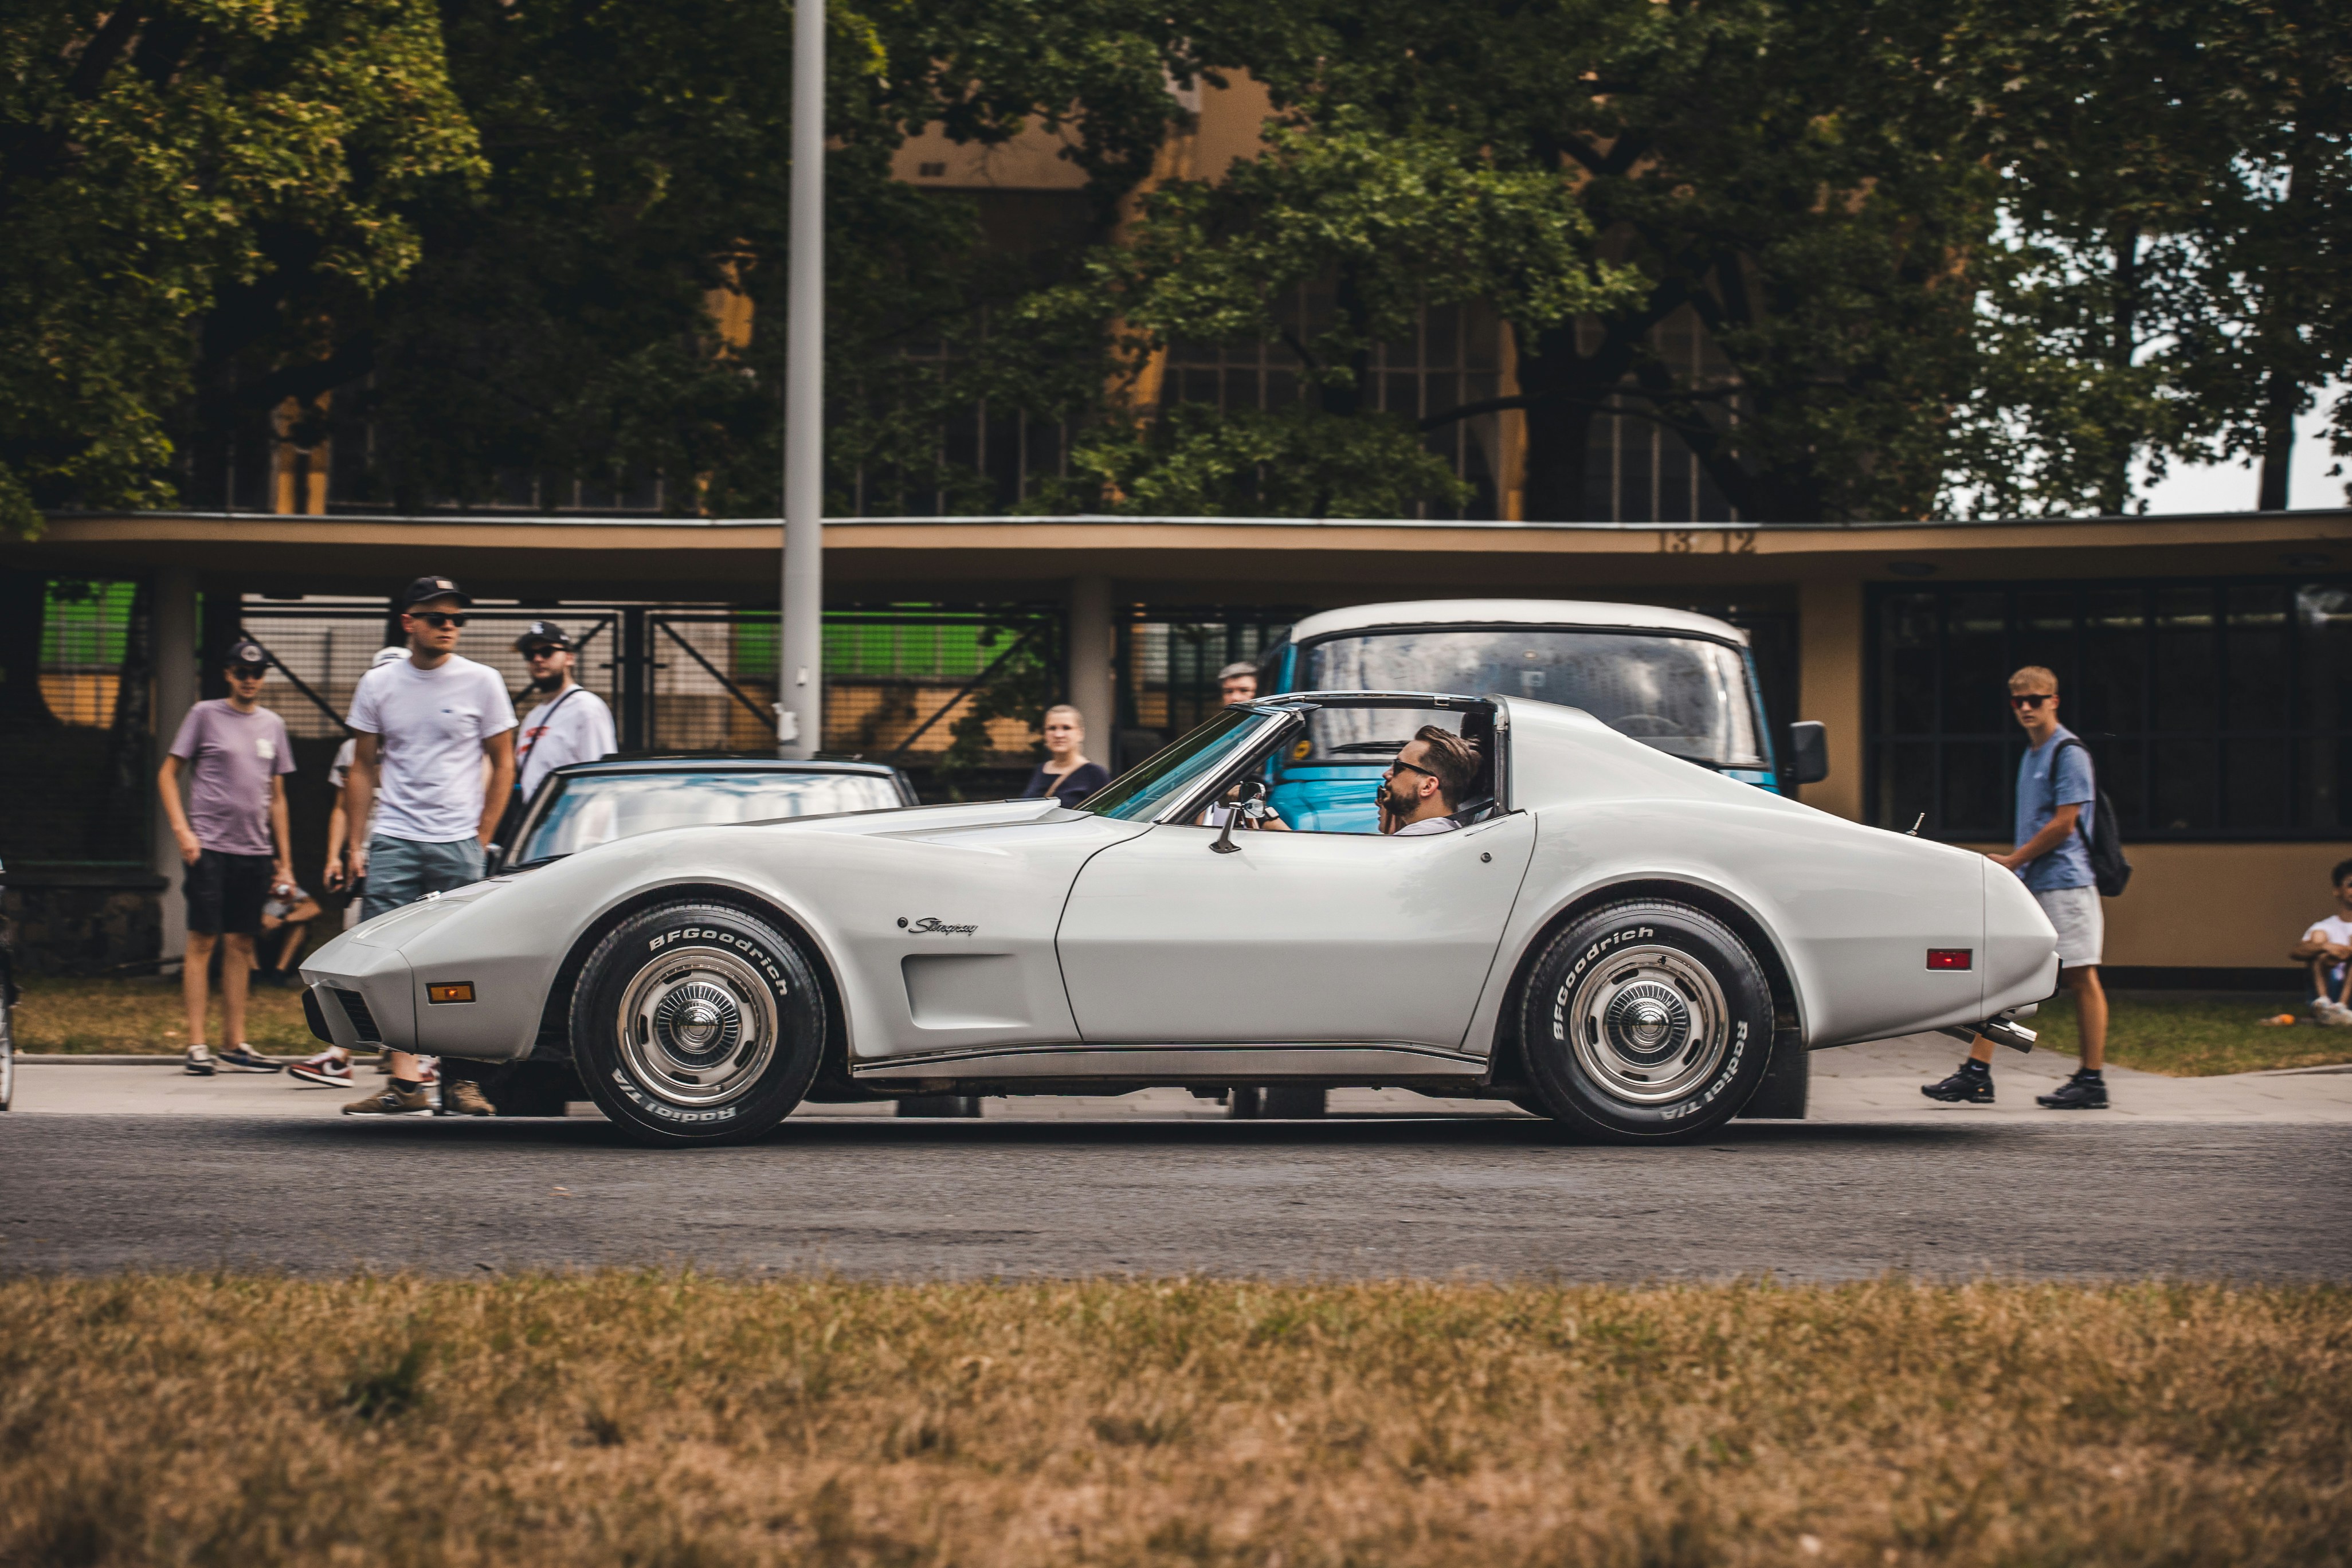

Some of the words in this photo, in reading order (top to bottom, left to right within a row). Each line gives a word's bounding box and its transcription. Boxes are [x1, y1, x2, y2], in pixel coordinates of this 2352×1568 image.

[908, 917, 978, 936] Stingray
[649, 927, 788, 996] BFGoodrich
[1554, 927, 1654, 1041] BFGoodrich
[1704, 1020, 1747, 1103] Radial
[645, 1103, 736, 1123] Radial
